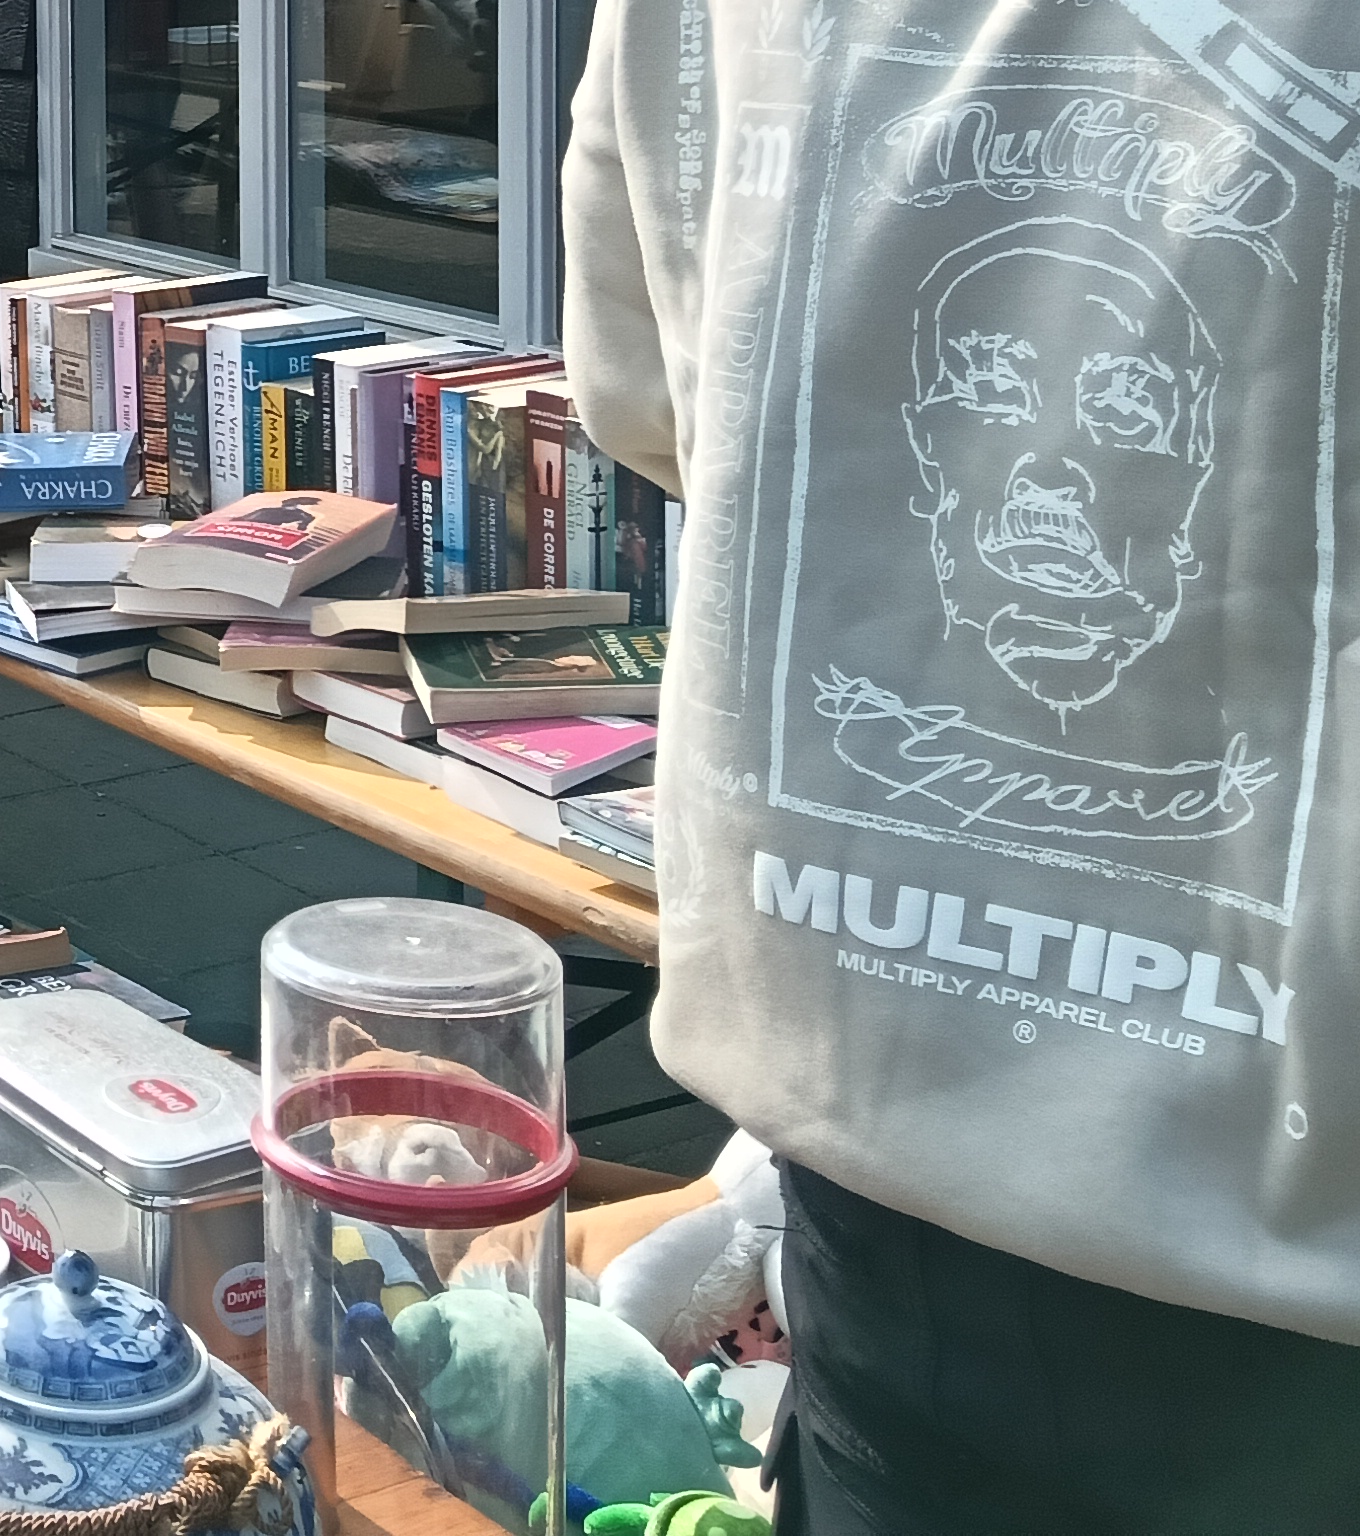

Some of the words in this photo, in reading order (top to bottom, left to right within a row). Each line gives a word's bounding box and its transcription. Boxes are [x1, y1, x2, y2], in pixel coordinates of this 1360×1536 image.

[227, 360, 237, 411] Esther
[321, 371, 331, 404] NICCI
[144, 426, 168, 457] TWO
[213, 350, 227, 482] TEGENLICHT
[322, 406, 332, 451] FRENCH
[425, 394, 438, 462] DENNIS
[445, 404, 456, 435] Ann
[229, 416, 239, 480] Verhoef
[446, 438, 458, 506] Brashares
[21, 479, 113, 500] CHAKRA
[144, 460, 169, 495] ZERO
[566, 462, 579, 541] GERRARD
[422, 479, 433, 567] GESLOTEN
[543, 507, 555, 529] DE
[574, 482, 586, 528] NICCI
[753, 850, 1295, 1047] MULTIPLY
[836, 948, 971, 996] MULTIPLY
[977, 979, 1115, 1034] APPAREL
[1121, 1017, 1207, 1057] CLUB
[138, 1080, 190, 1113] Duyvis
[0, 1208, 51, 1262] Duyvis
